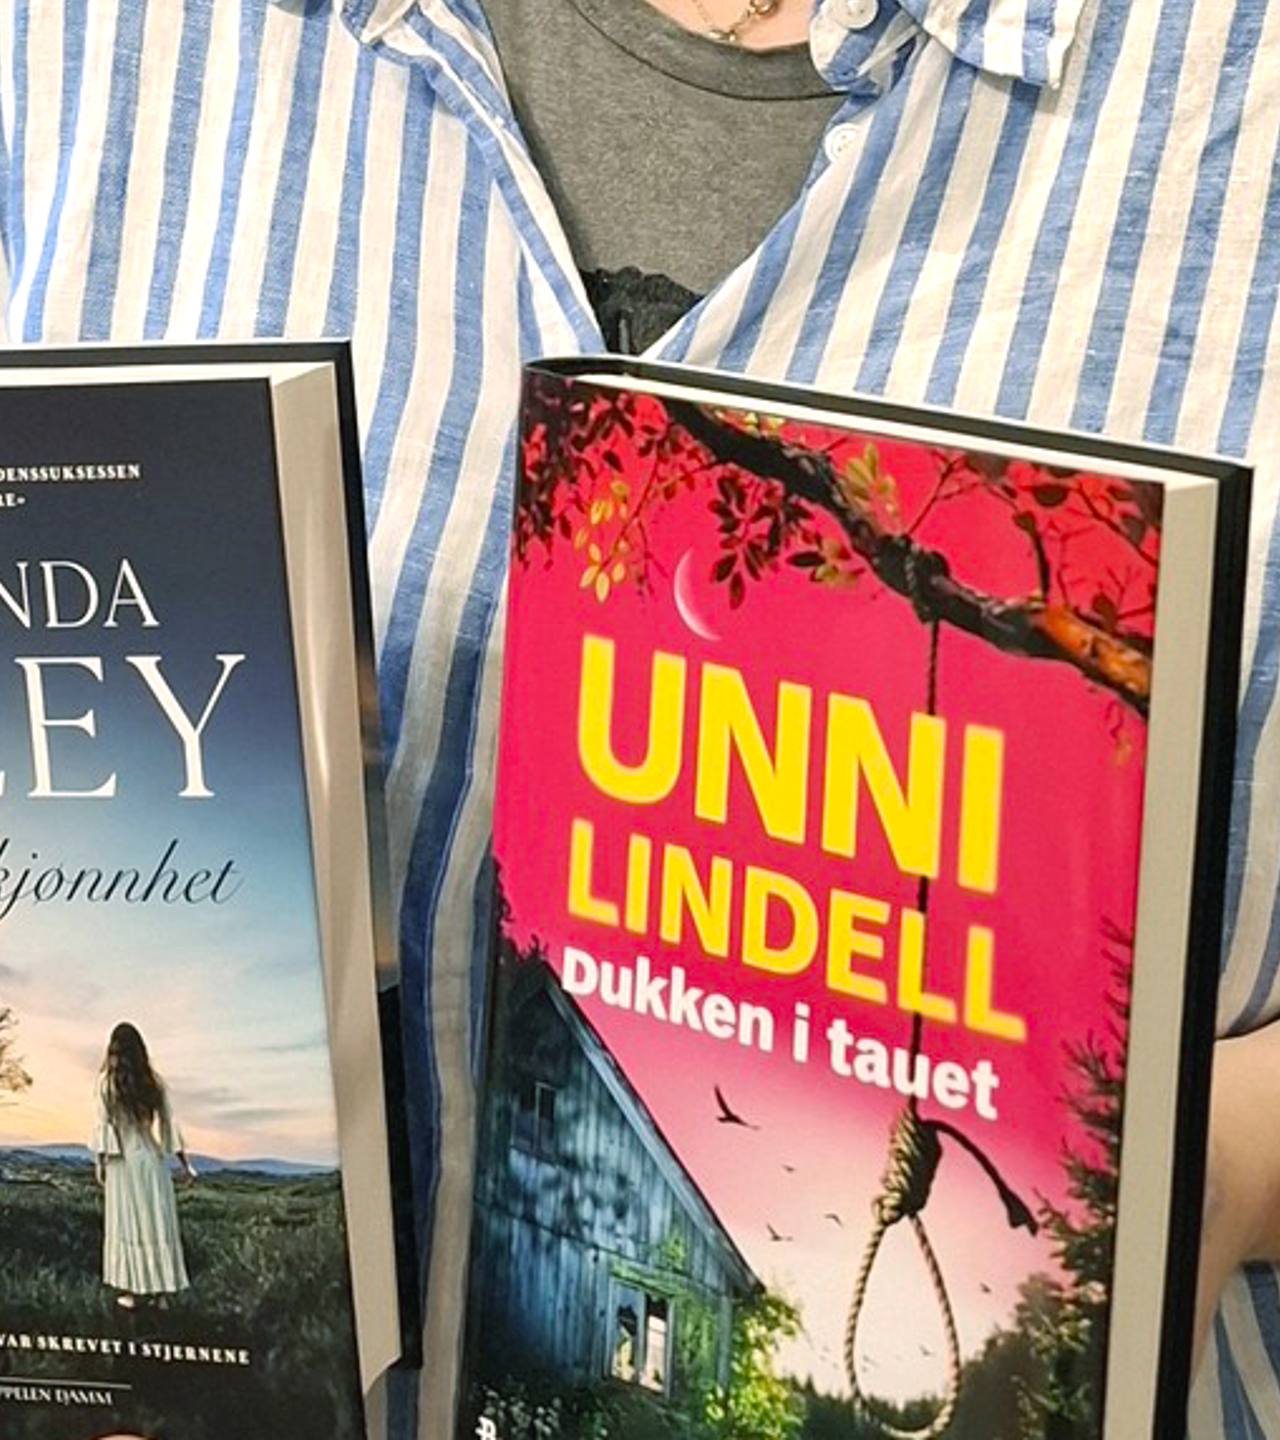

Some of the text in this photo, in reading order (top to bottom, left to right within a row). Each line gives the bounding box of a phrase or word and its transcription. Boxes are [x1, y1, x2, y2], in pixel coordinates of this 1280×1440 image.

[577, 633, 1005, 896] UNNI
[566, 818, 1028, 1044] LINDELL
[562, 946, 1000, 1122] Dukken i tauet
[37, 1335, 123, 1357] SKREVET
[140, 1341, 251, 1366] STJERNENE
